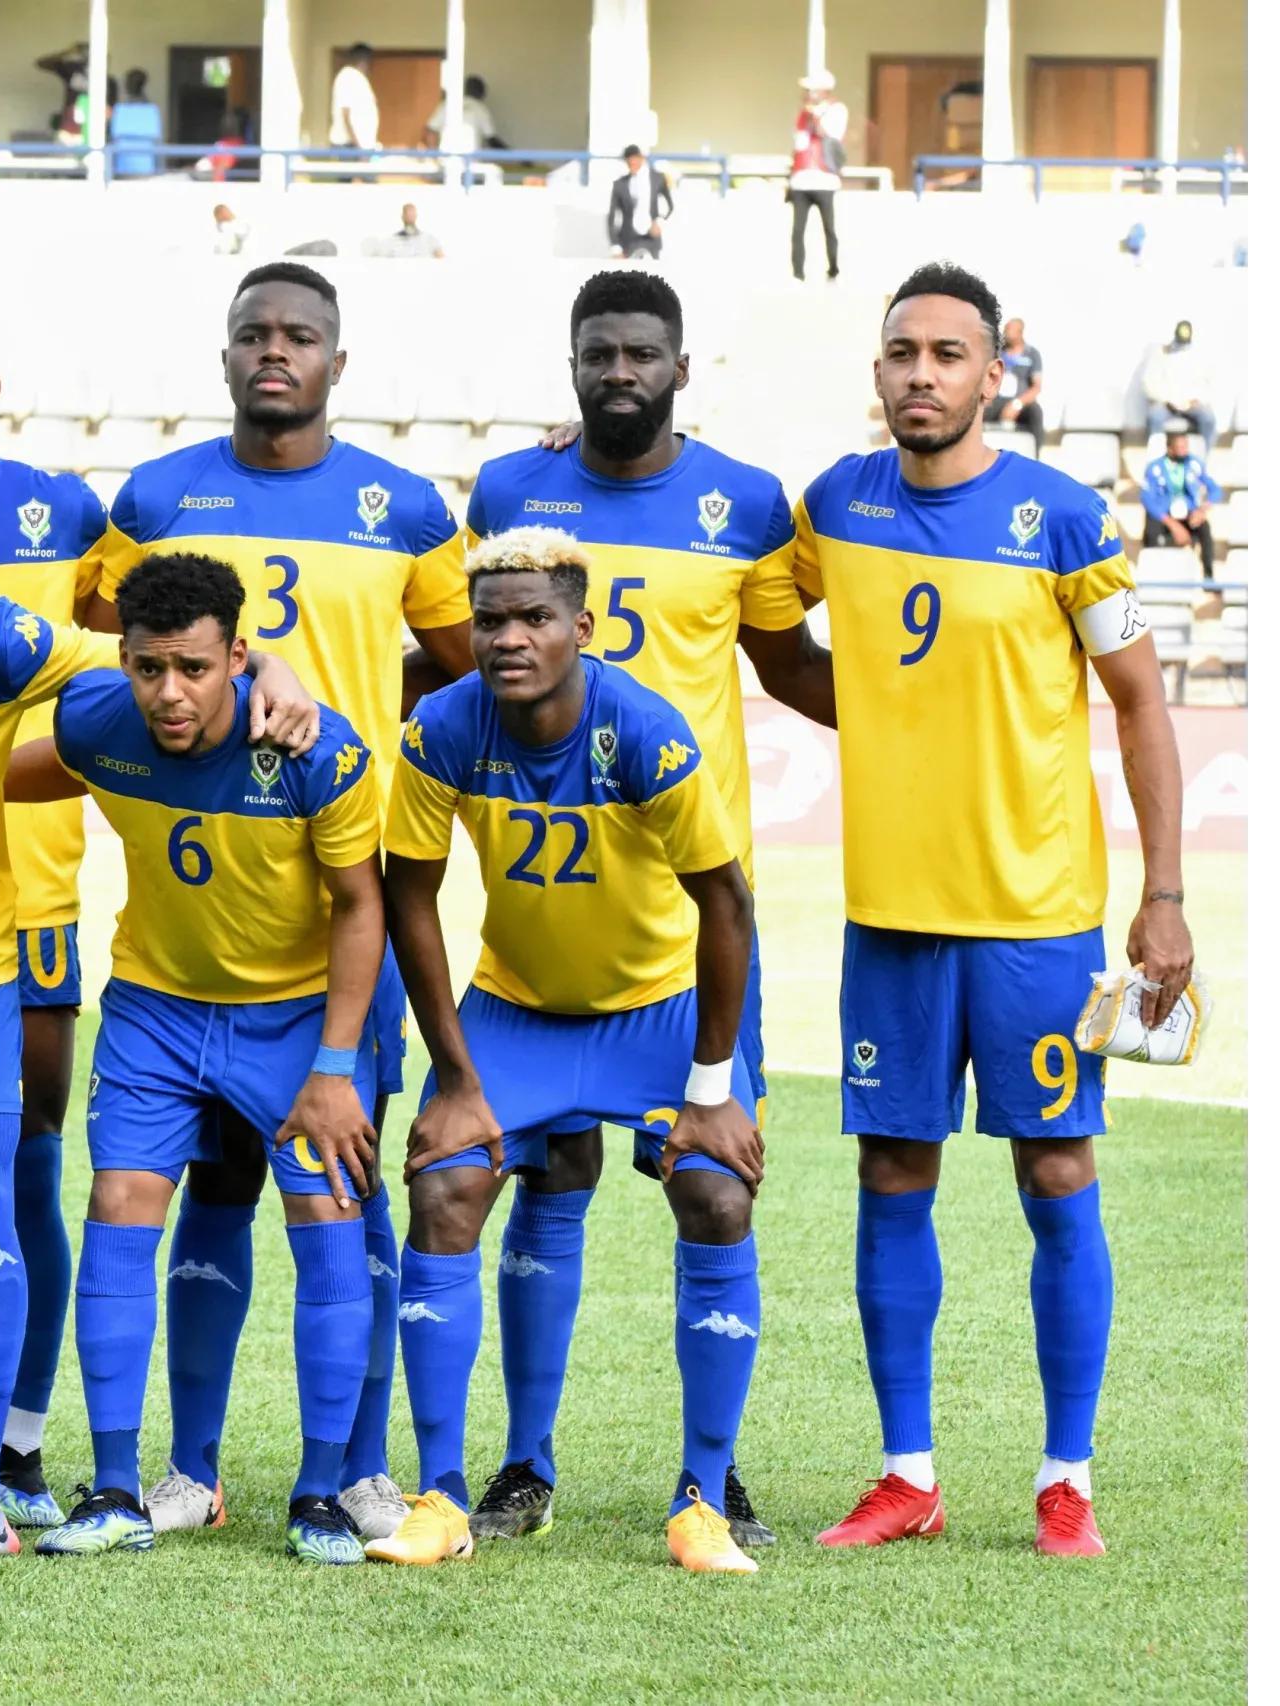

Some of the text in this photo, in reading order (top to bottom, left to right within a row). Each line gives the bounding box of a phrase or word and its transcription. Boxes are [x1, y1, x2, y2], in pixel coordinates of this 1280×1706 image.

[525, 500, 582, 513] Kappa
[848, 500, 896, 519] Kappa
[348, 531, 391, 545] FEGAFOOT
[689, 541, 731, 555] FEGAFOOT
[15, 549, 57, 558] FEGAFOOT
[996, 546, 1041, 561] FEGAFOOT
[257, 555, 300, 640] 3
[602, 577, 646, 663] 5
[900, 582, 942, 666] 9
[95, 755, 151, 777] Kappa
[244, 795, 287, 806] FEGAFOOT
[168, 815, 213, 887] 6
[505, 808, 597, 887] 22
[1031, 1033, 1078, 1120] 9
